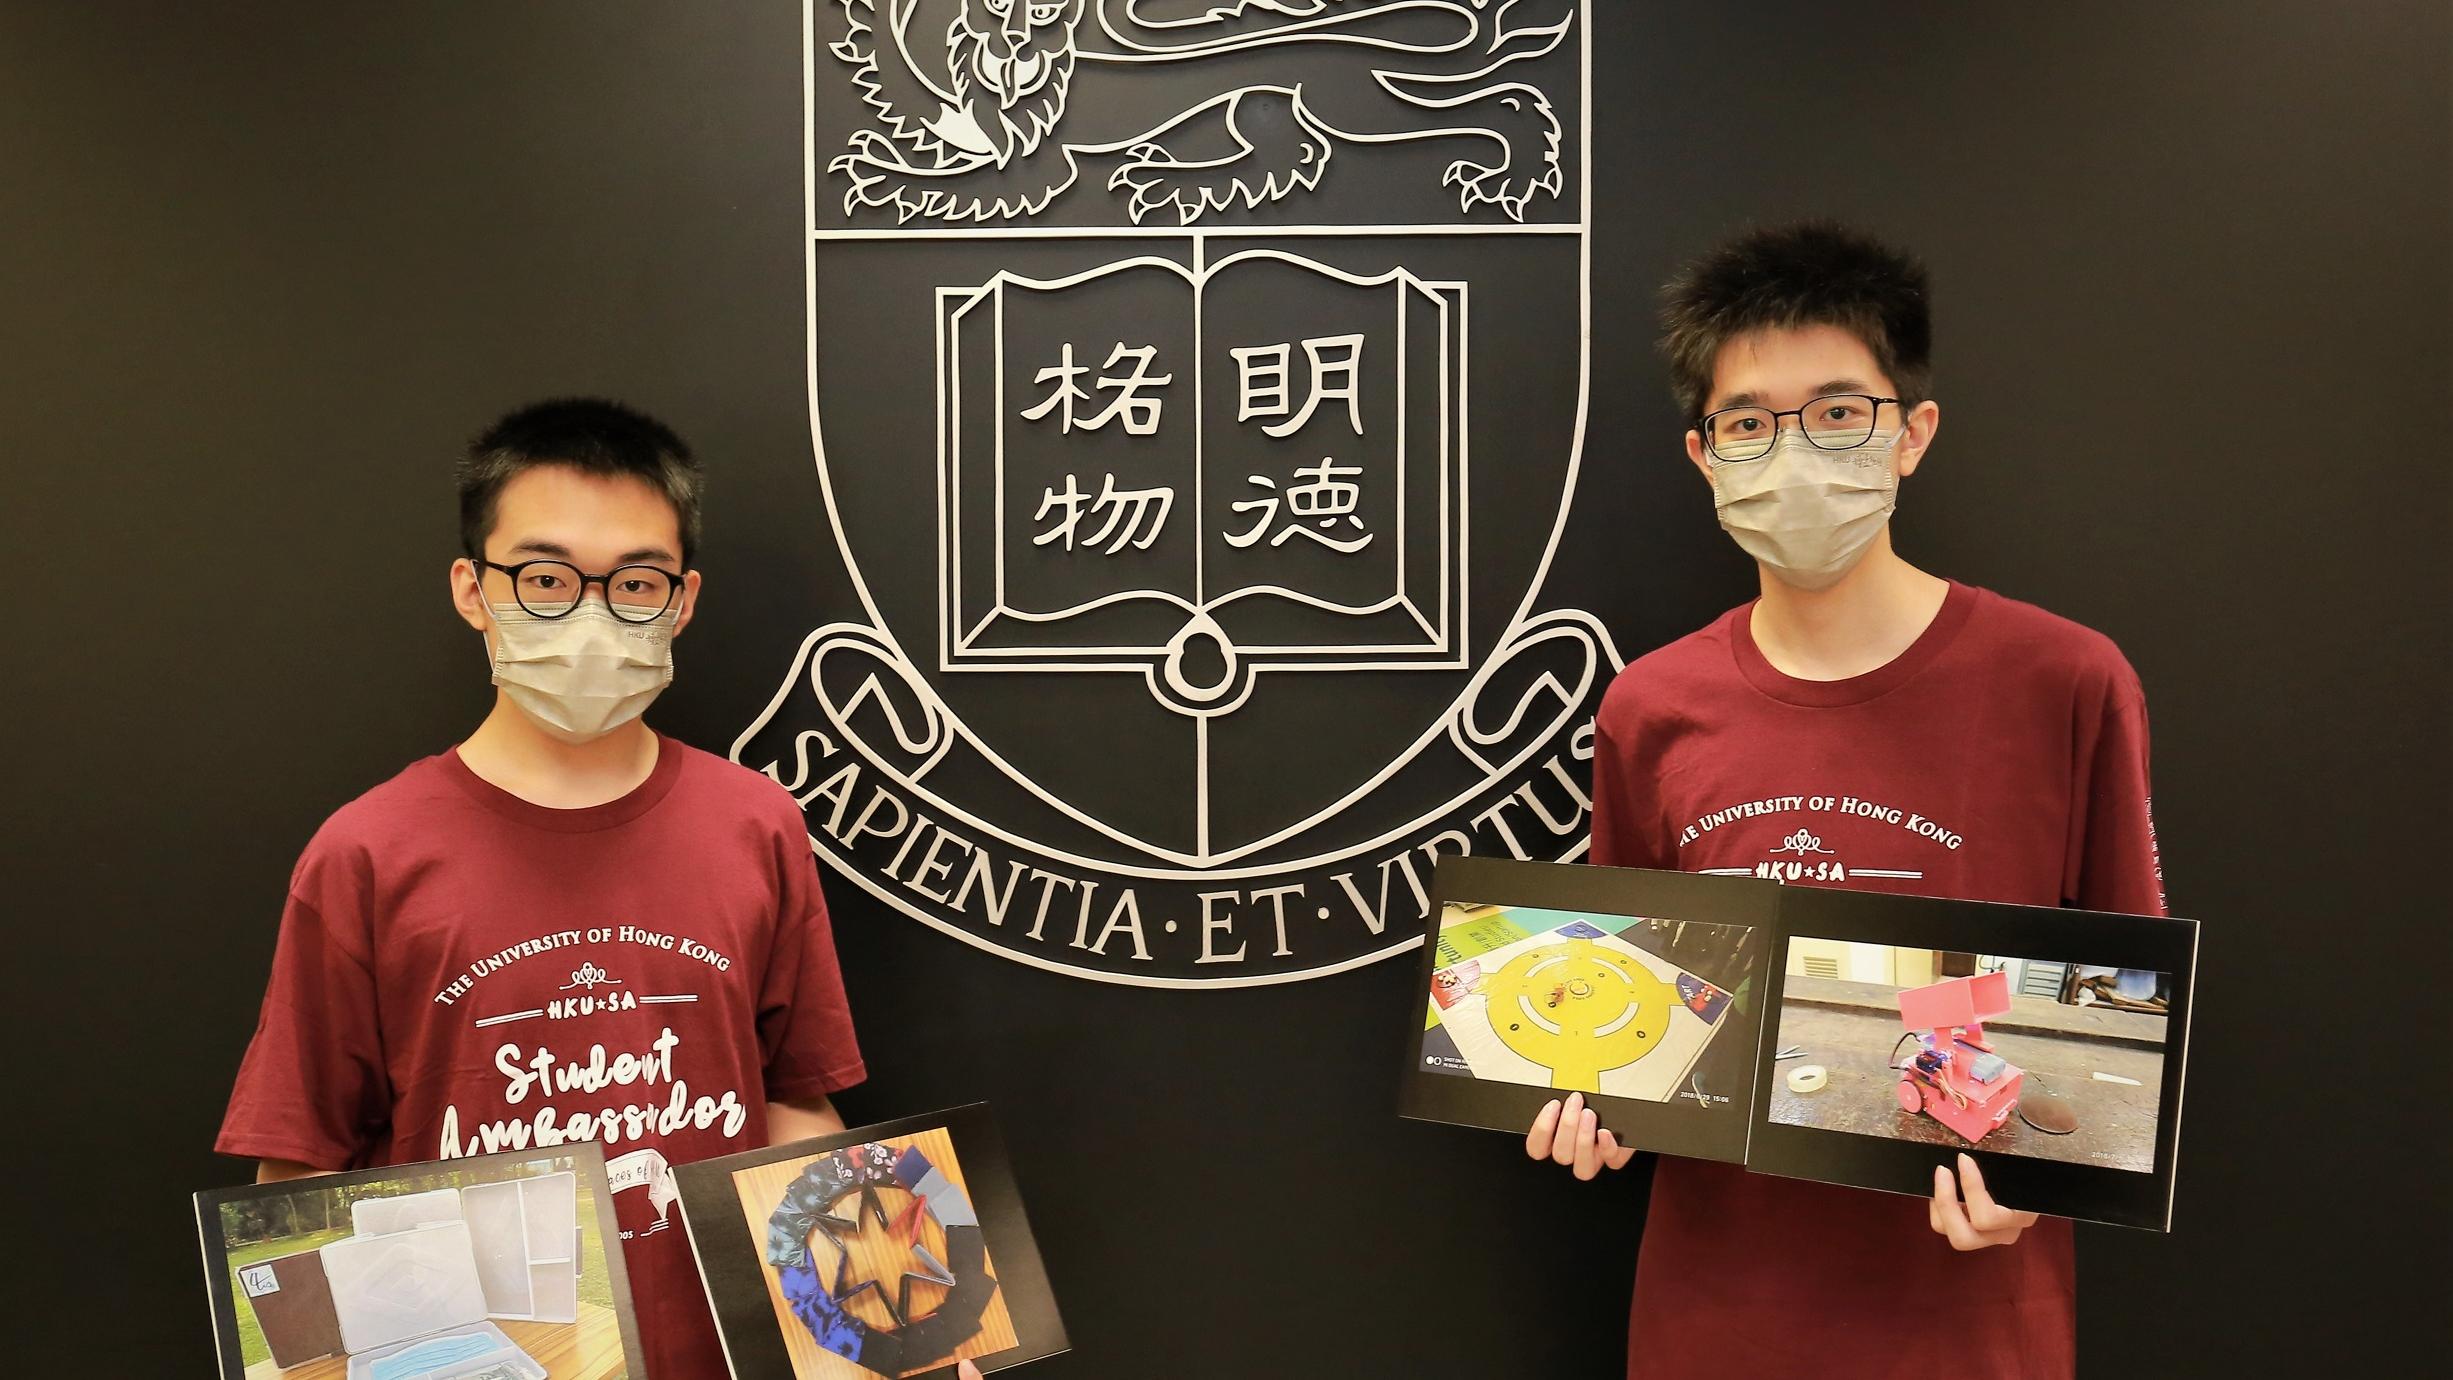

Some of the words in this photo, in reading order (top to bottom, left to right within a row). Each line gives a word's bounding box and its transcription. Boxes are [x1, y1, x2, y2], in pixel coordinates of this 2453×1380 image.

[760, 729, 1153, 961] SAPIENTIA
[1194, 883, 1306, 964] ET
[1698, 796, 1804, 832] UNIVERSITY
[1808, 796, 1836, 811] OF
[1839, 796, 1903, 825] HONG
[1904, 814, 1964, 850] KONG
[434, 974, 475, 1006] THE
[469, 930, 582, 978] UNIVERSITY
[587, 928, 612, 943] OF
[618, 925, 675, 950] HONG
[678, 937, 731, 972] KONG
